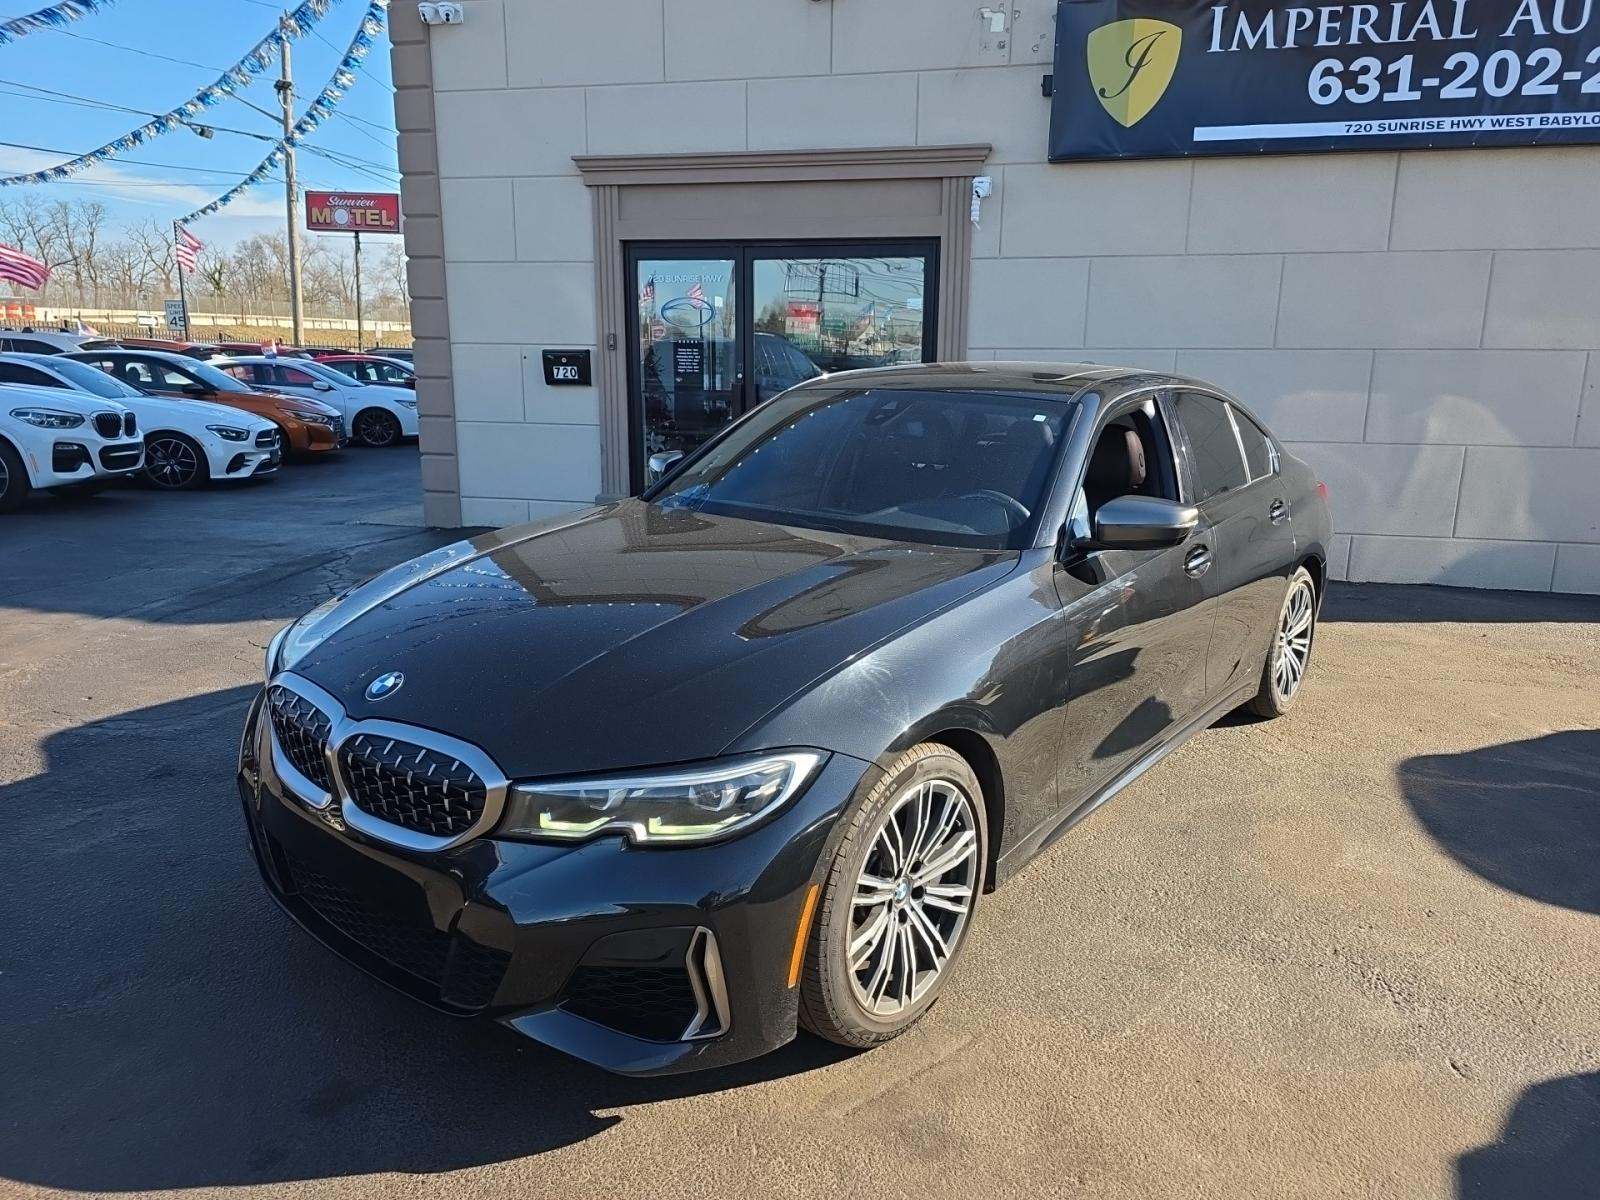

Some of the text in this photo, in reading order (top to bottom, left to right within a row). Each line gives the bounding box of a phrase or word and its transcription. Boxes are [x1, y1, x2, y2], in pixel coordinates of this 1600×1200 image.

[1206, 0, 1479, 53] IMPERIAL
[1344, 114, 1600, 134] 720 SUNRISE HWY WEST BABYLO
[310, 206, 396, 227] MOTEL
[170, 316, 185, 327] 45
[554, 367, 578, 378] 720
